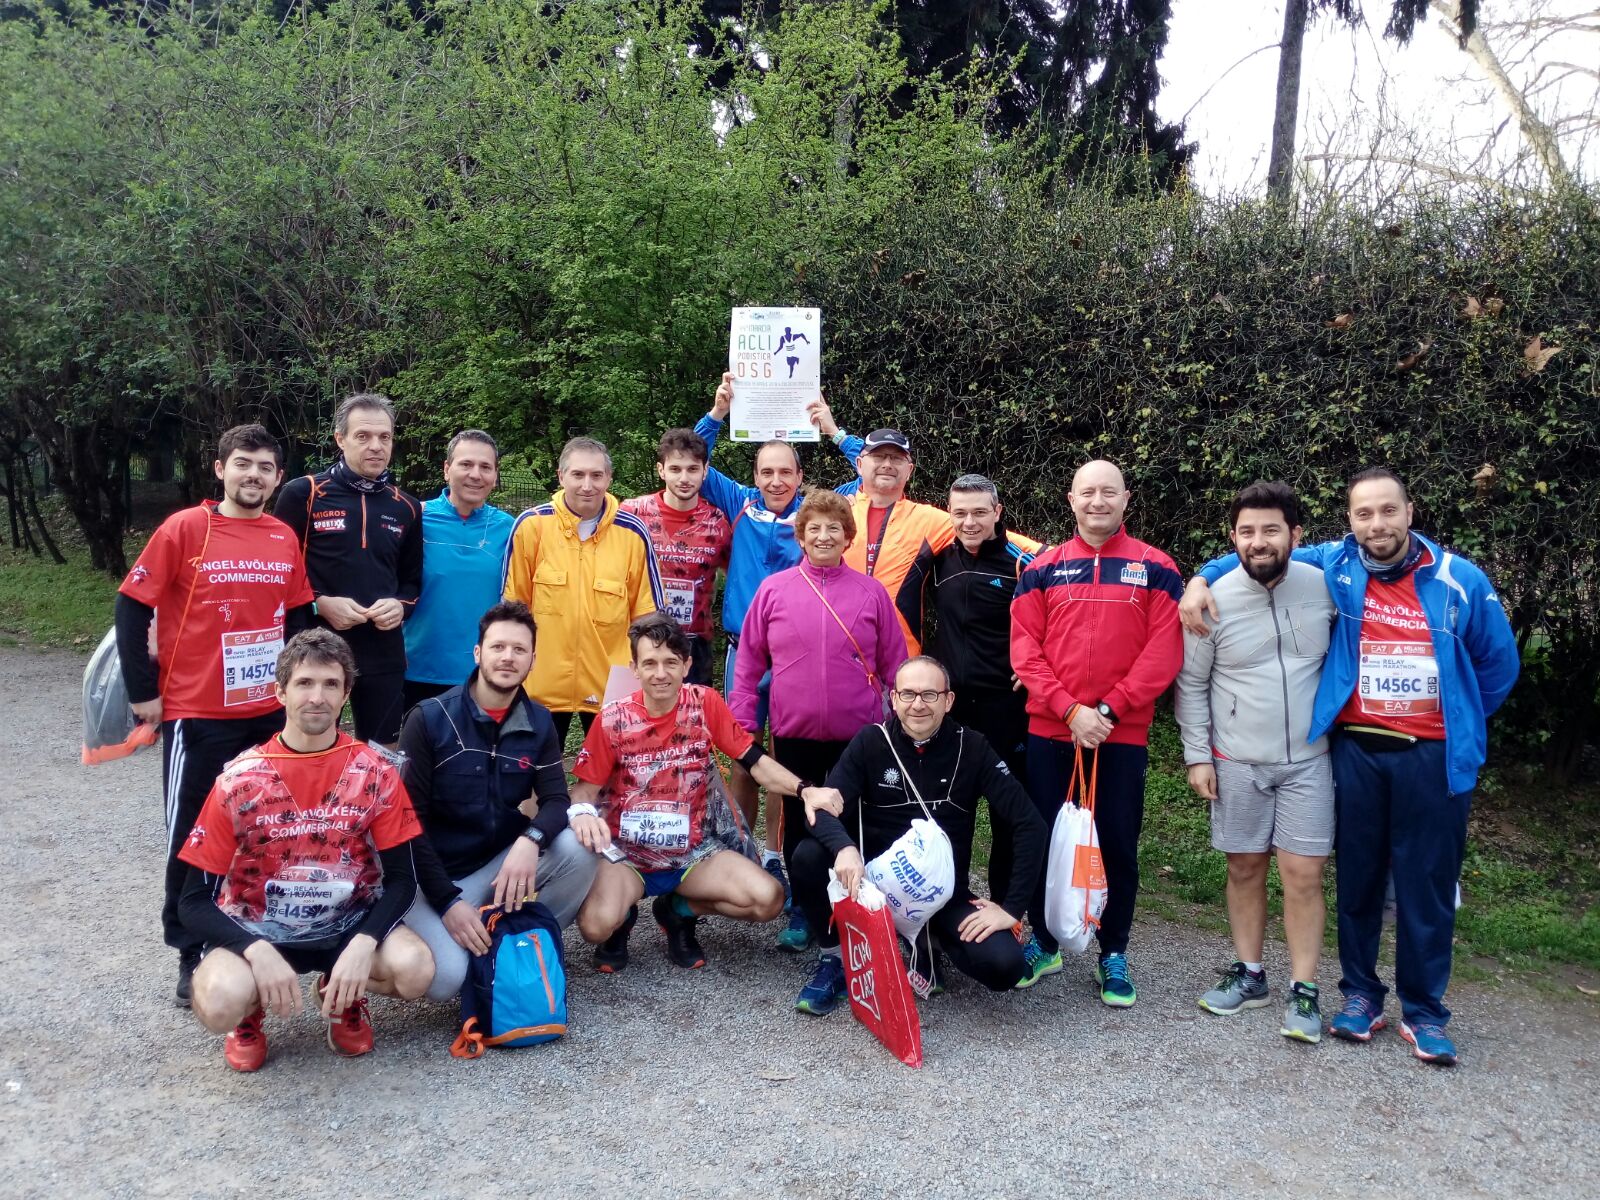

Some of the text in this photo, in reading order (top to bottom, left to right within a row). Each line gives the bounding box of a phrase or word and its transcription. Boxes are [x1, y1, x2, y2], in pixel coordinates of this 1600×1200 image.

[738, 334, 771, 351] ACLI
[737, 352, 772, 361] PODISTICA
[312, 509, 347, 520] MIGROS
[196, 558, 294, 573] ENGEL&VÖLKERS
[208, 572, 286, 584] COMMERCIAL
[234, 635, 251, 643] EA7
[247, 685, 268, 697] EA7
[1374, 677, 1422, 693] 1456C
[1384, 700, 1412, 711] EA7
[895, 849, 927, 888] CORRI
[887, 892, 902, 908] coop
